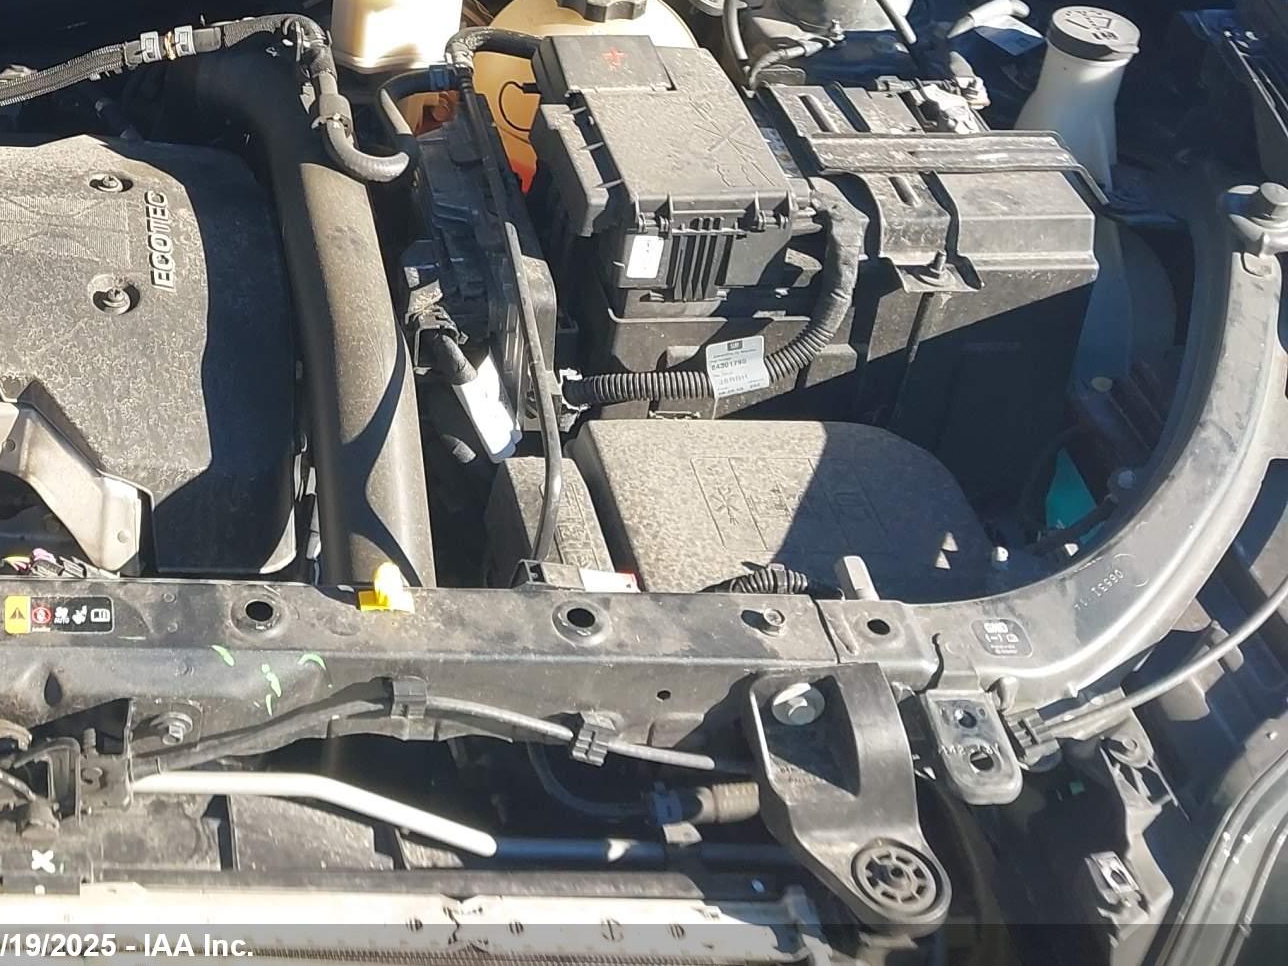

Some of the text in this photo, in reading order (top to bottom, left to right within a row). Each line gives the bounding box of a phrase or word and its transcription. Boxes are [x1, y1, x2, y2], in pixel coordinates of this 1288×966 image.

[144, 190, 176, 292] ECOTEC
[53, 616, 70, 625] AUTO
[983, 622, 1009, 634] GND
